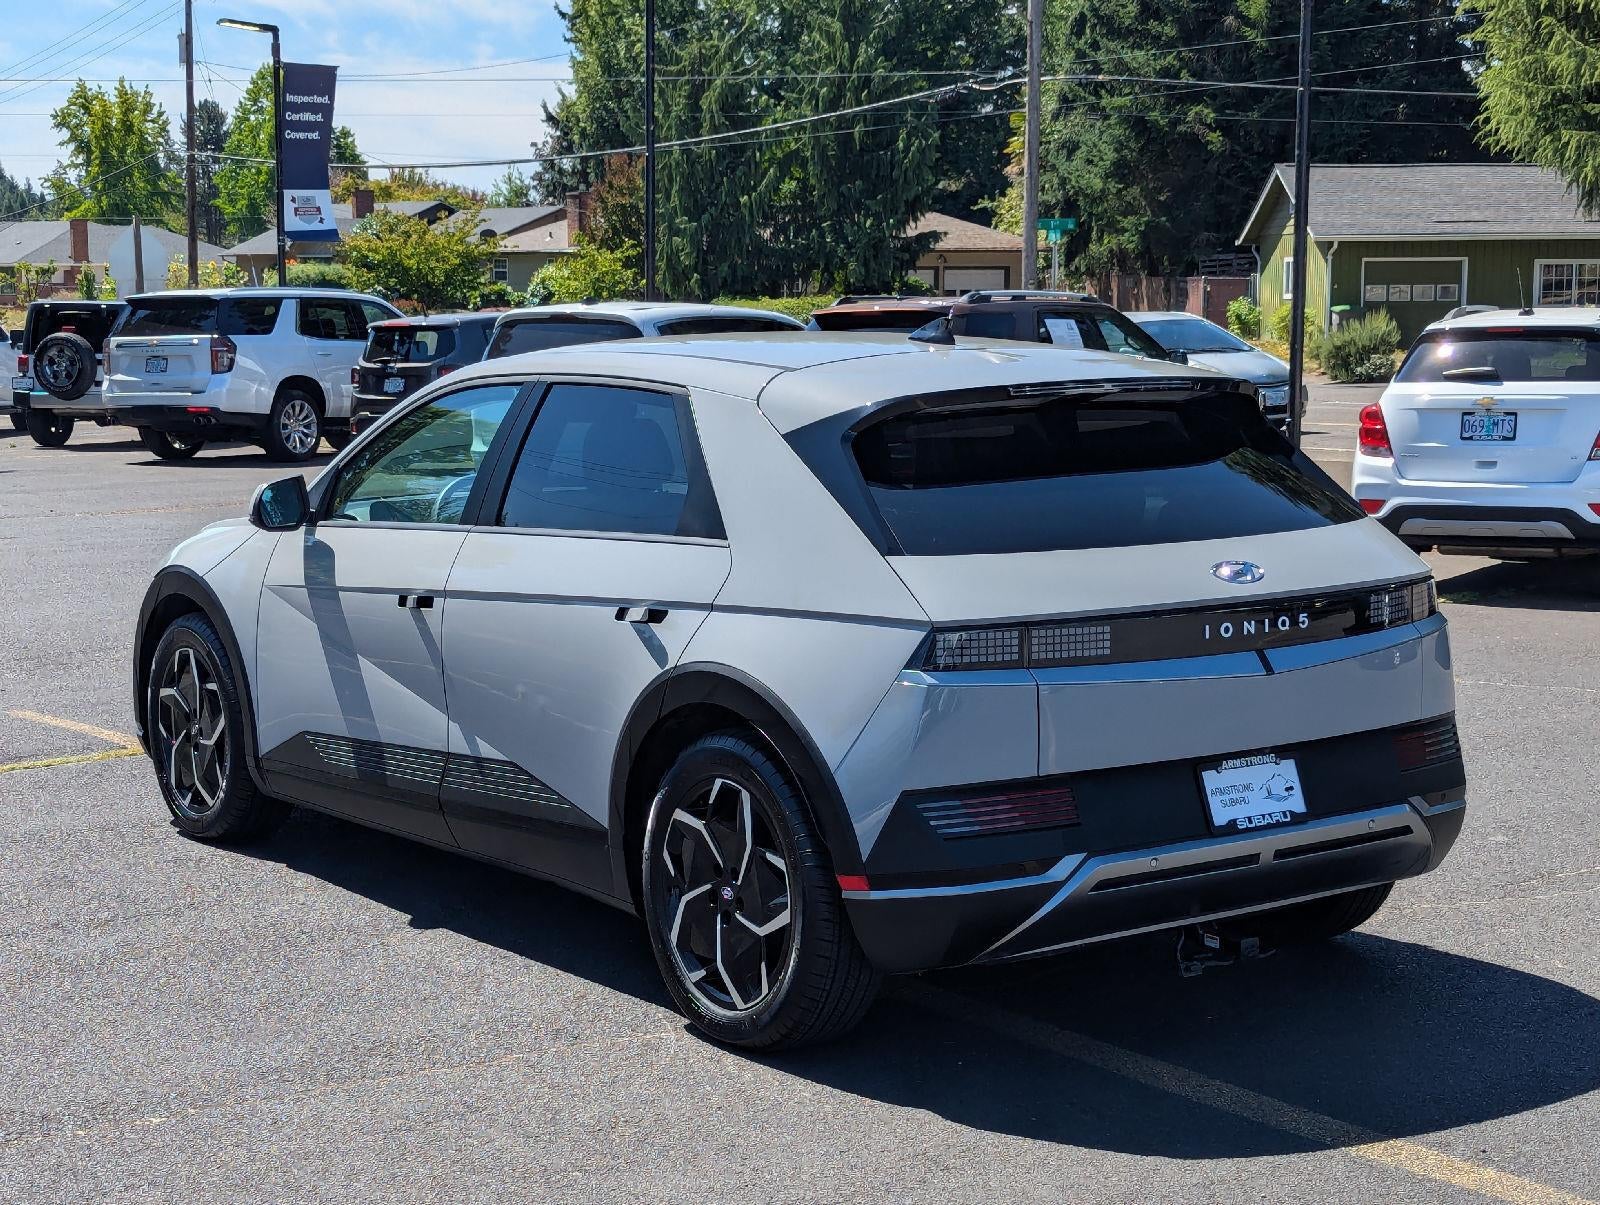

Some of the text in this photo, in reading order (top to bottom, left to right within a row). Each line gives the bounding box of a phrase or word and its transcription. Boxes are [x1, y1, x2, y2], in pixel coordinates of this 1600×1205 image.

[286, 93, 331, 104] Inspected.
[285, 111, 324, 122] Certified.
[285, 129, 321, 140] Covered.
[1463, 419, 1513, 434] 069 MTS
[1221, 753, 1276, 770] ARMSTRONG
[1210, 782, 1255, 797] ARMSTRONG
[1219, 796, 1250, 808] SUBARU
[1236, 810, 1291, 829] SUBARU
